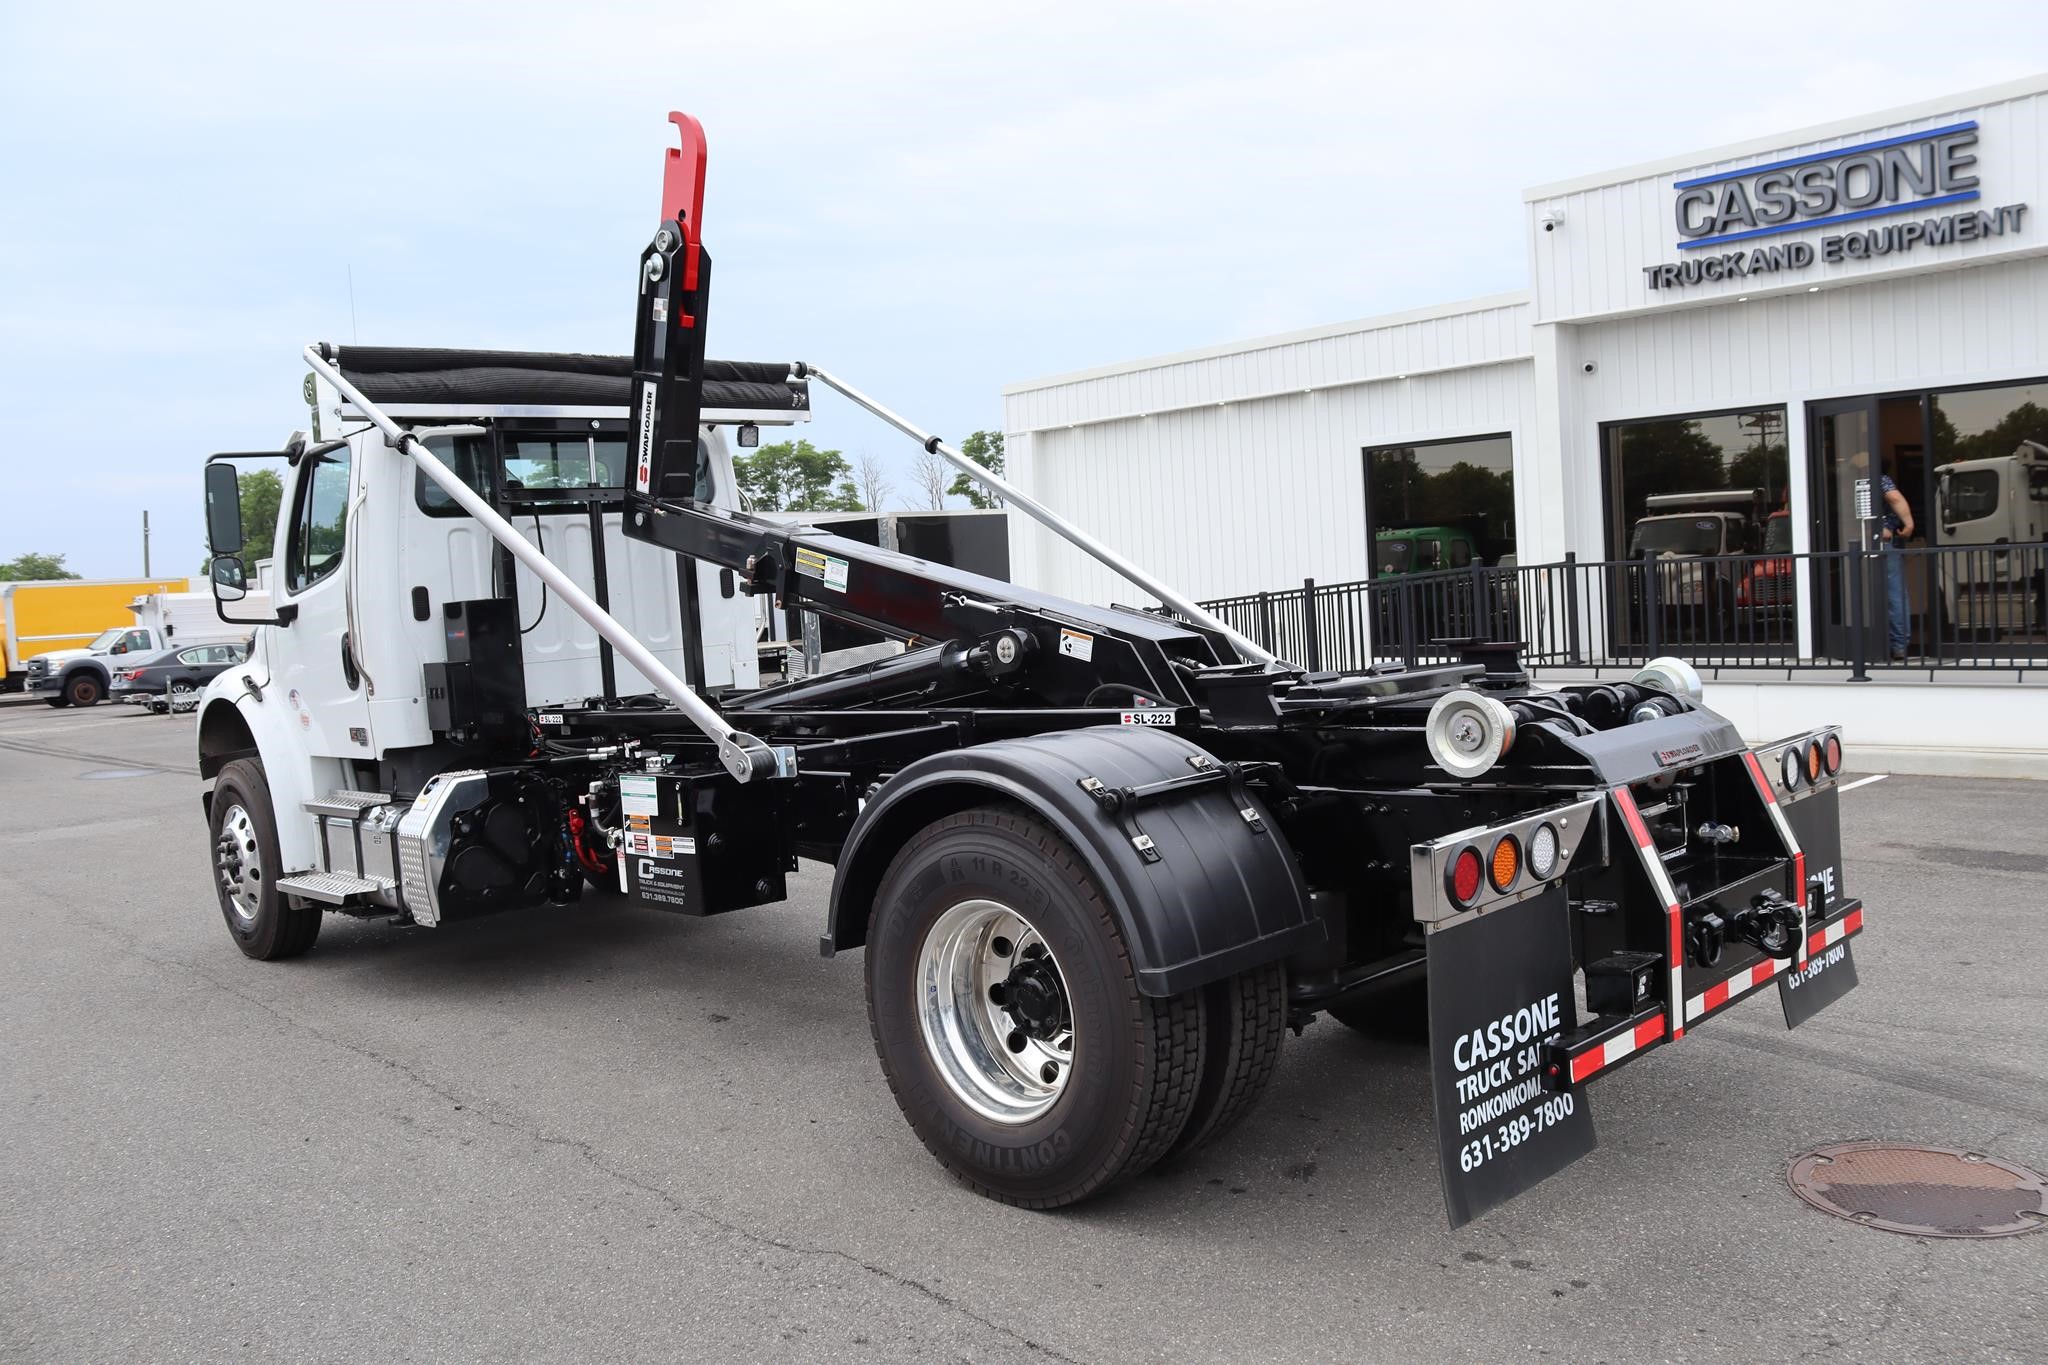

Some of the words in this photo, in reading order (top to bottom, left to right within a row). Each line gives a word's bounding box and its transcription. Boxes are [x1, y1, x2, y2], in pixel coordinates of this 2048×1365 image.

[1675, 132, 1980, 237] CASSONE
[1821, 203, 2027, 264] EQUIPMENT
[642, 391, 653, 463] SWAPLOADER
[1453, 992, 1561, 1072] CASSONE
[1455, 1056, 1513, 1104] TRUCK
[1460, 1093, 1574, 1173] 631-389-7800
